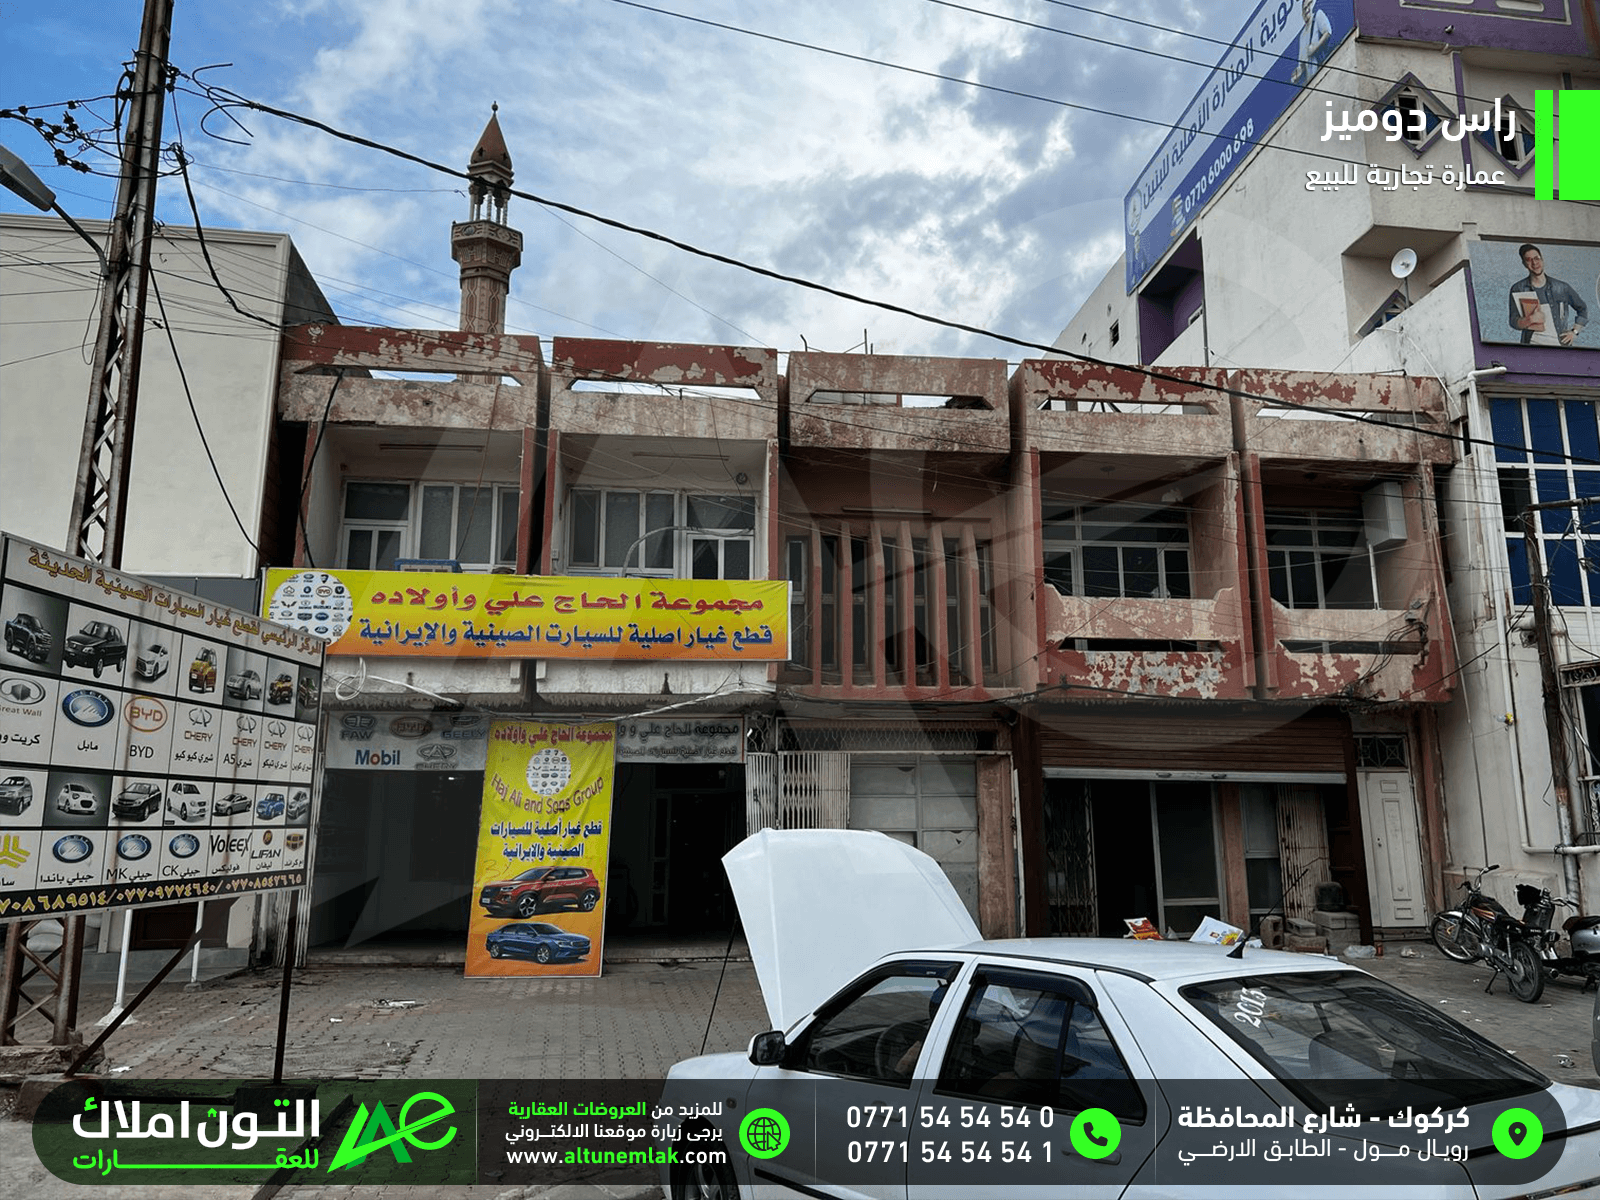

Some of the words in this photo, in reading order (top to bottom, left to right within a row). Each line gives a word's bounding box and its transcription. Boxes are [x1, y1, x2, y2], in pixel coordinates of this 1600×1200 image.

[1212, 37, 1254, 111] المنارة
[1184, 175, 1207, 214] 0770
[1208, 143, 1233, 185] 6000
[1233, 117, 1254, 154] 698
[1143, 154, 1170, 210] للبنين
[28, 546, 92, 584] الحديثة
[95, 568, 153, 603] الصينية
[154, 592, 205, 619] السيارات
[370, 586, 477, 612] وأولاده
[484, 590, 545, 616] علي
[553, 591, 641, 614] الحاج
[649, 591, 764, 615] مجموعة
[205, 608, 232, 629] غيار
[232, 616, 261, 636] لقطع
[261, 629, 298, 649] الرئيسي
[358, 618, 458, 647] والإيرانية
[461, 620, 540, 648] الصينية
[628, 623, 681, 649] اصلية
[683, 625, 728, 649] غيار
[731, 624, 774, 651] قطع
[22, 707, 43, 717] Wall
[130, 706, 163, 722] BYD
[184, 730, 213, 742] CHERY
[340, 730, 374, 741] FAW
[441, 729, 487, 740] GEELY
[551, 726, 575, 746] الحاج
[640, 722, 661, 742] علي
[664, 720, 692, 738] الحاج
[11, 734, 41, 746] كريت
[77, 740, 99, 752] مابل
[232, 737, 258, 748] CHERY
[264, 741, 288, 752] CHERY
[129, 745, 154, 759] BYD
[223, 753, 236, 765] A5
[355, 749, 400, 766] Mobil
[491, 773, 510, 802] Haj
[509, 789, 523, 808] Ali
[523, 796, 544, 814] and
[545, 797, 571, 815] Sons
[572, 776, 604, 807] Group
[490, 821, 533, 839] للسيارات
[562, 821, 581, 839] غيار
[583, 821, 602, 839] قطع
[250, 848, 282, 860] LIFAN
[546, 842, 585, 861] الصينية
[106, 867, 128, 881] MK
[162, 865, 179, 877] CK
[180, 868, 201, 879] جيلي
[211, 864, 240, 875] فوليكس
[255, 861, 273, 871] ليفان
[40, 873, 65, 884] باندا
[66, 872, 95, 886] جيلي
[129, 870, 153, 883] جيلي
[1233, 986, 1267, 1029] 2013
